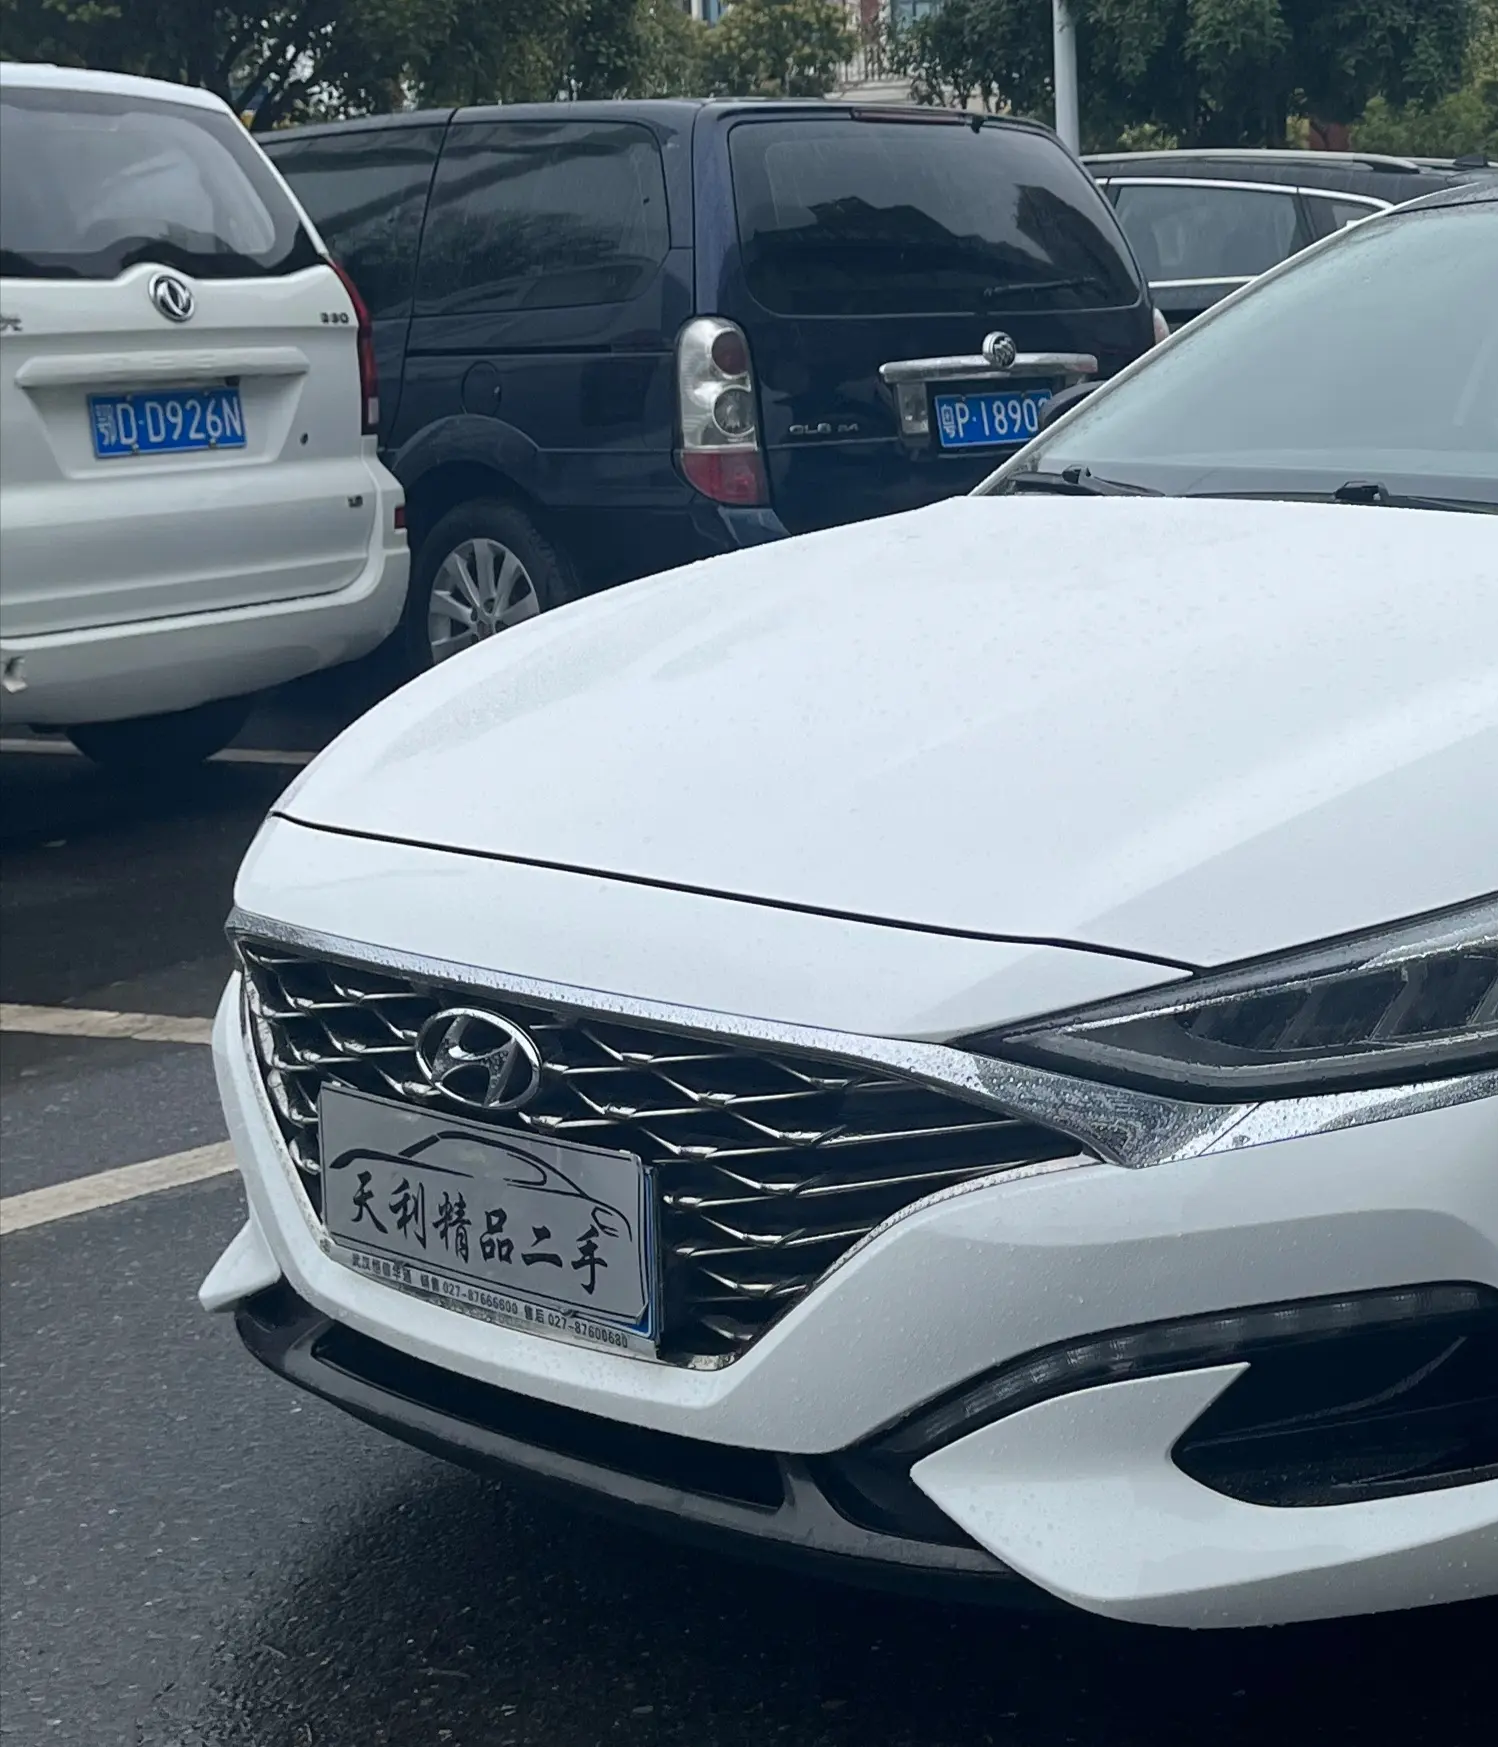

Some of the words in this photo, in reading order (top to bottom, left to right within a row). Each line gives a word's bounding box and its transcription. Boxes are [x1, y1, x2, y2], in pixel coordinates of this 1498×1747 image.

[351, 1170, 609, 1295] 天利精品二手
